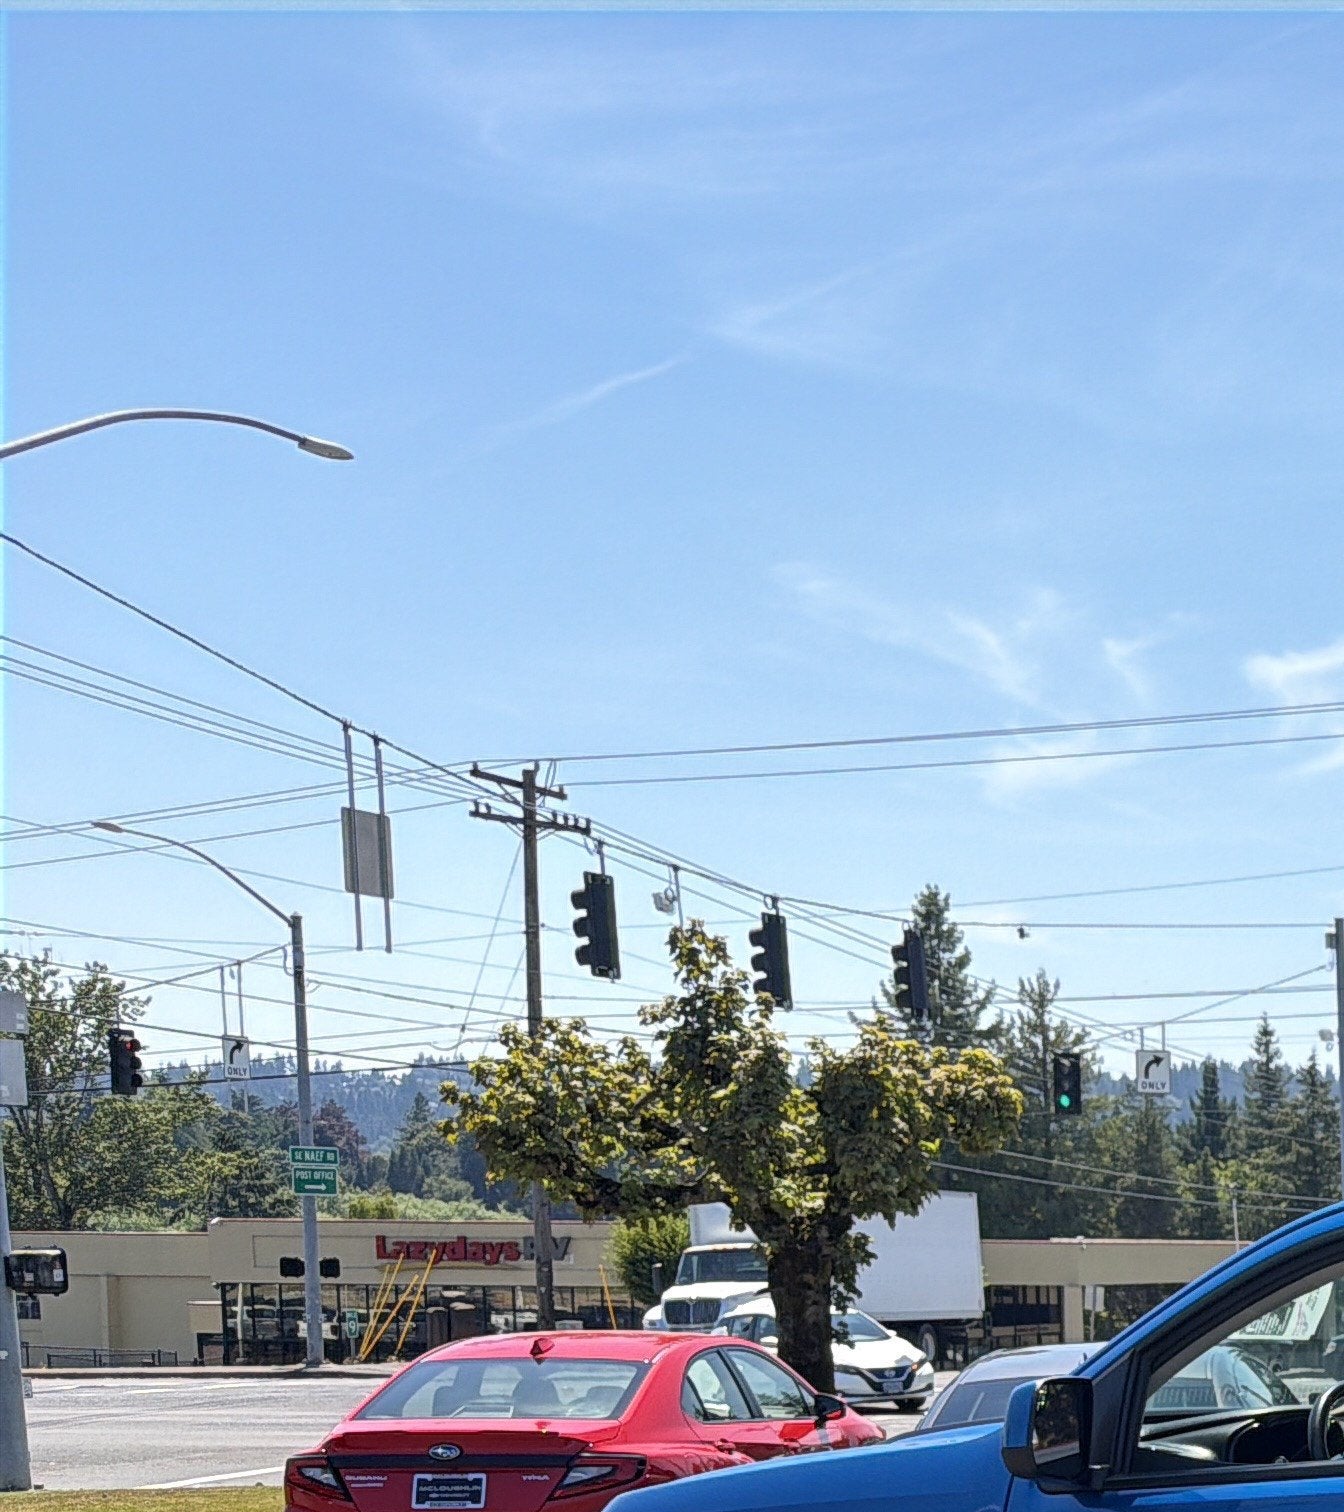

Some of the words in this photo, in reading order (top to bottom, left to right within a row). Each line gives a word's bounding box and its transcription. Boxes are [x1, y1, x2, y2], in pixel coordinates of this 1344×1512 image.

[227, 1066, 247, 1076] ONLY
[1141, 1081, 1167, 1090] ONLY
[294, 1151, 303, 1160] SE
[295, 1170, 312, 1180] POST
[313, 1171, 335, 1181] OFFICE
[375, 1235, 521, 1265] Lazydays
